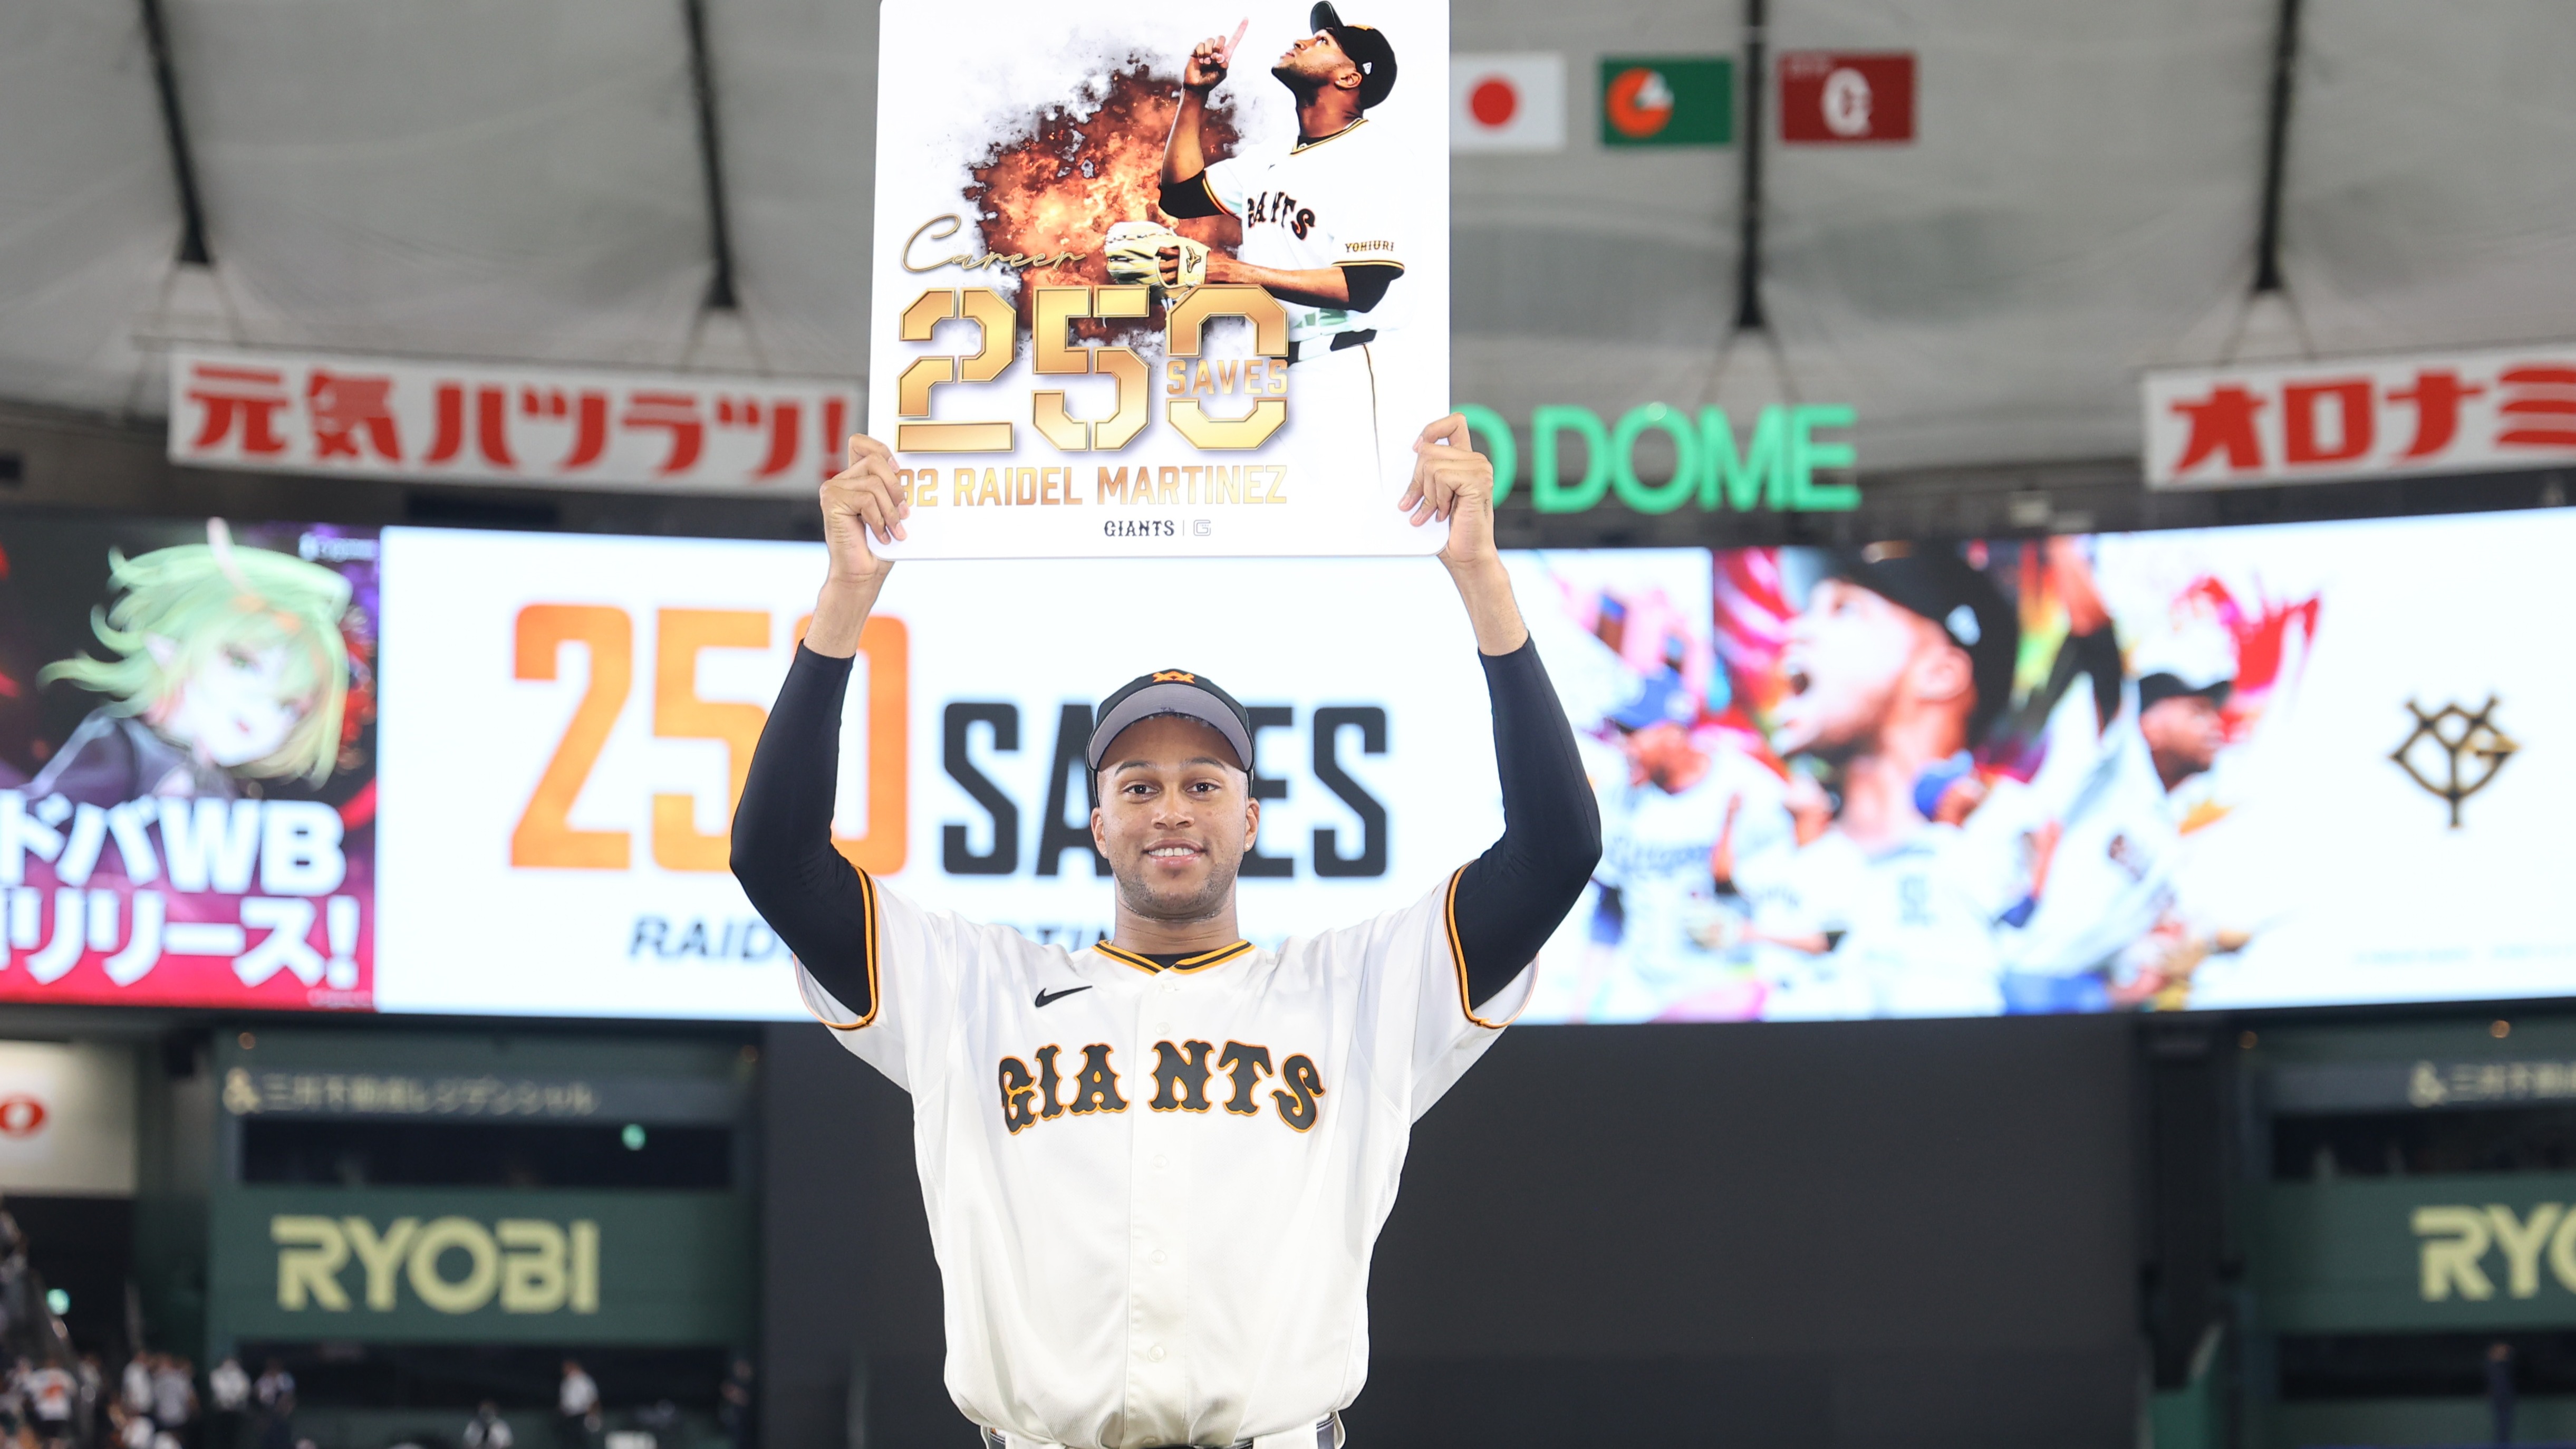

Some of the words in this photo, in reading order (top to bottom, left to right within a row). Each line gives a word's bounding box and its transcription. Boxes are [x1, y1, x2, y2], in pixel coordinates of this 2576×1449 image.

[901, 213, 1086, 273] Career
[895, 284, 1289, 453] 250
[1166, 359, 1289, 395] SAVES
[1531, 402, 1863, 515] DOME
[2169, 363, 2576, 481] オロナミ
[895, 468, 939, 507] 92
[953, 466, 1083, 506] RAIDEL
[1097, 465, 1287, 505] MARTINEZ
[1104, 520, 1175, 537] GIANTS
[510, 603, 909, 876] 250
[942, 702, 1389, 878] SAES
[0, 886, 361, 990] リリース!
[629, 916, 795, 962] RAID
[998, 1038, 1326, 1136] GIANTS
[270, 1214, 601, 1314] RYOBI
